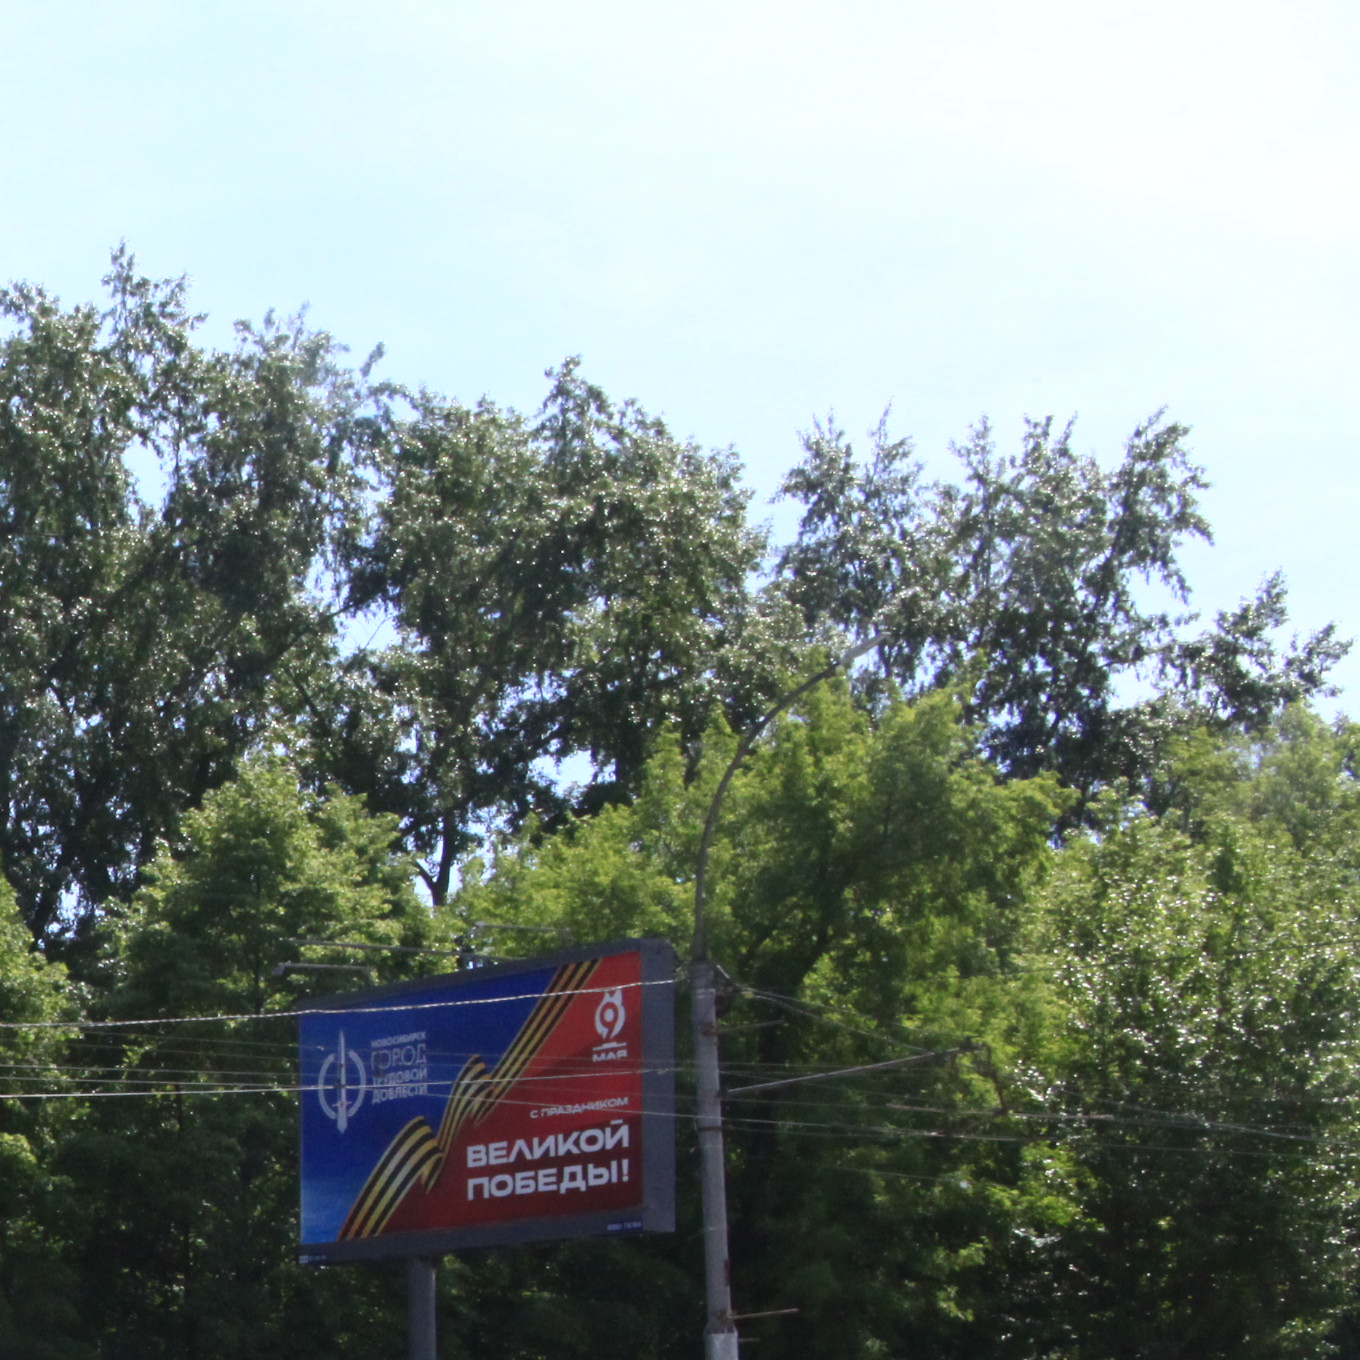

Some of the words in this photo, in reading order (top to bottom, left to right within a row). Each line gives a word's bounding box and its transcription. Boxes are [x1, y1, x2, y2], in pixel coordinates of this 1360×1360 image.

[595, 993, 625, 1040] 9
[371, 1043, 427, 1069] ГОРОД
[592, 1049, 627, 1062] МАЯ
[530, 1110, 539, 1119] С
[540, 1097, 629, 1118] ПРАЗДНИКОМ
[467, 1119, 629, 1168] ВЕЛИКОЙ
[467, 1159, 629, 1200] ПОБЕДЫ!
